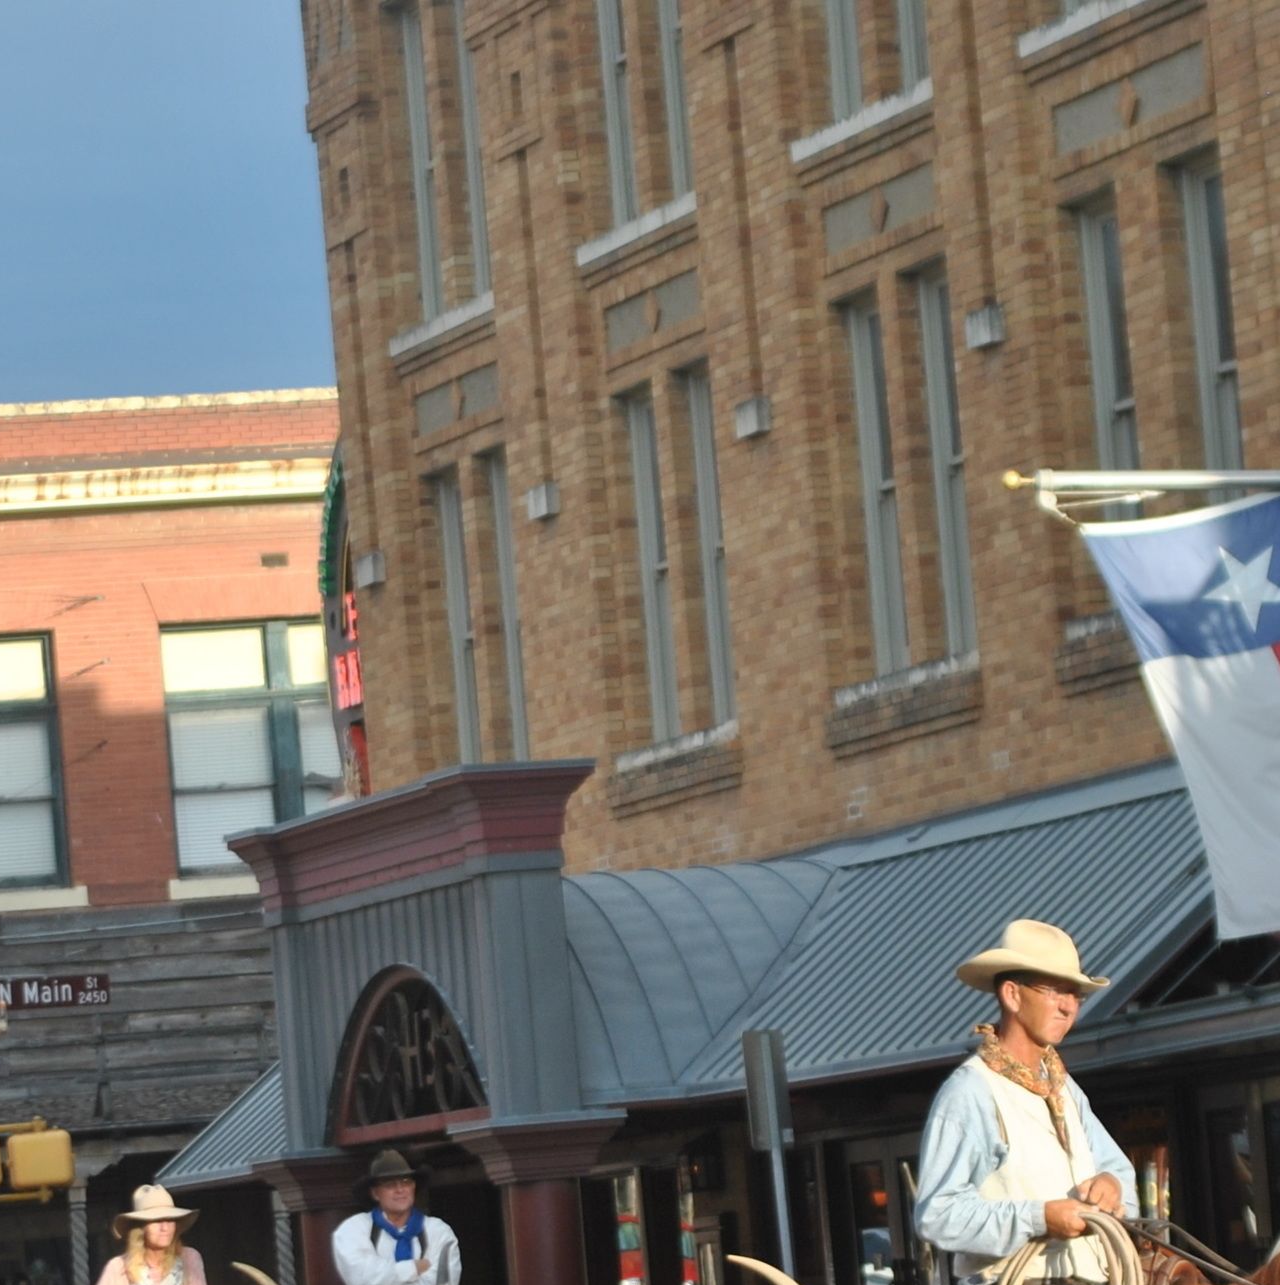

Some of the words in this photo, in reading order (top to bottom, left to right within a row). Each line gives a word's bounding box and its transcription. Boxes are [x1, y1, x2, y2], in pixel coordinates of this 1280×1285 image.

[23, 980, 73, 1005] Main
[86, 976, 98, 989] St
[78, 991, 108, 1004] 2450
